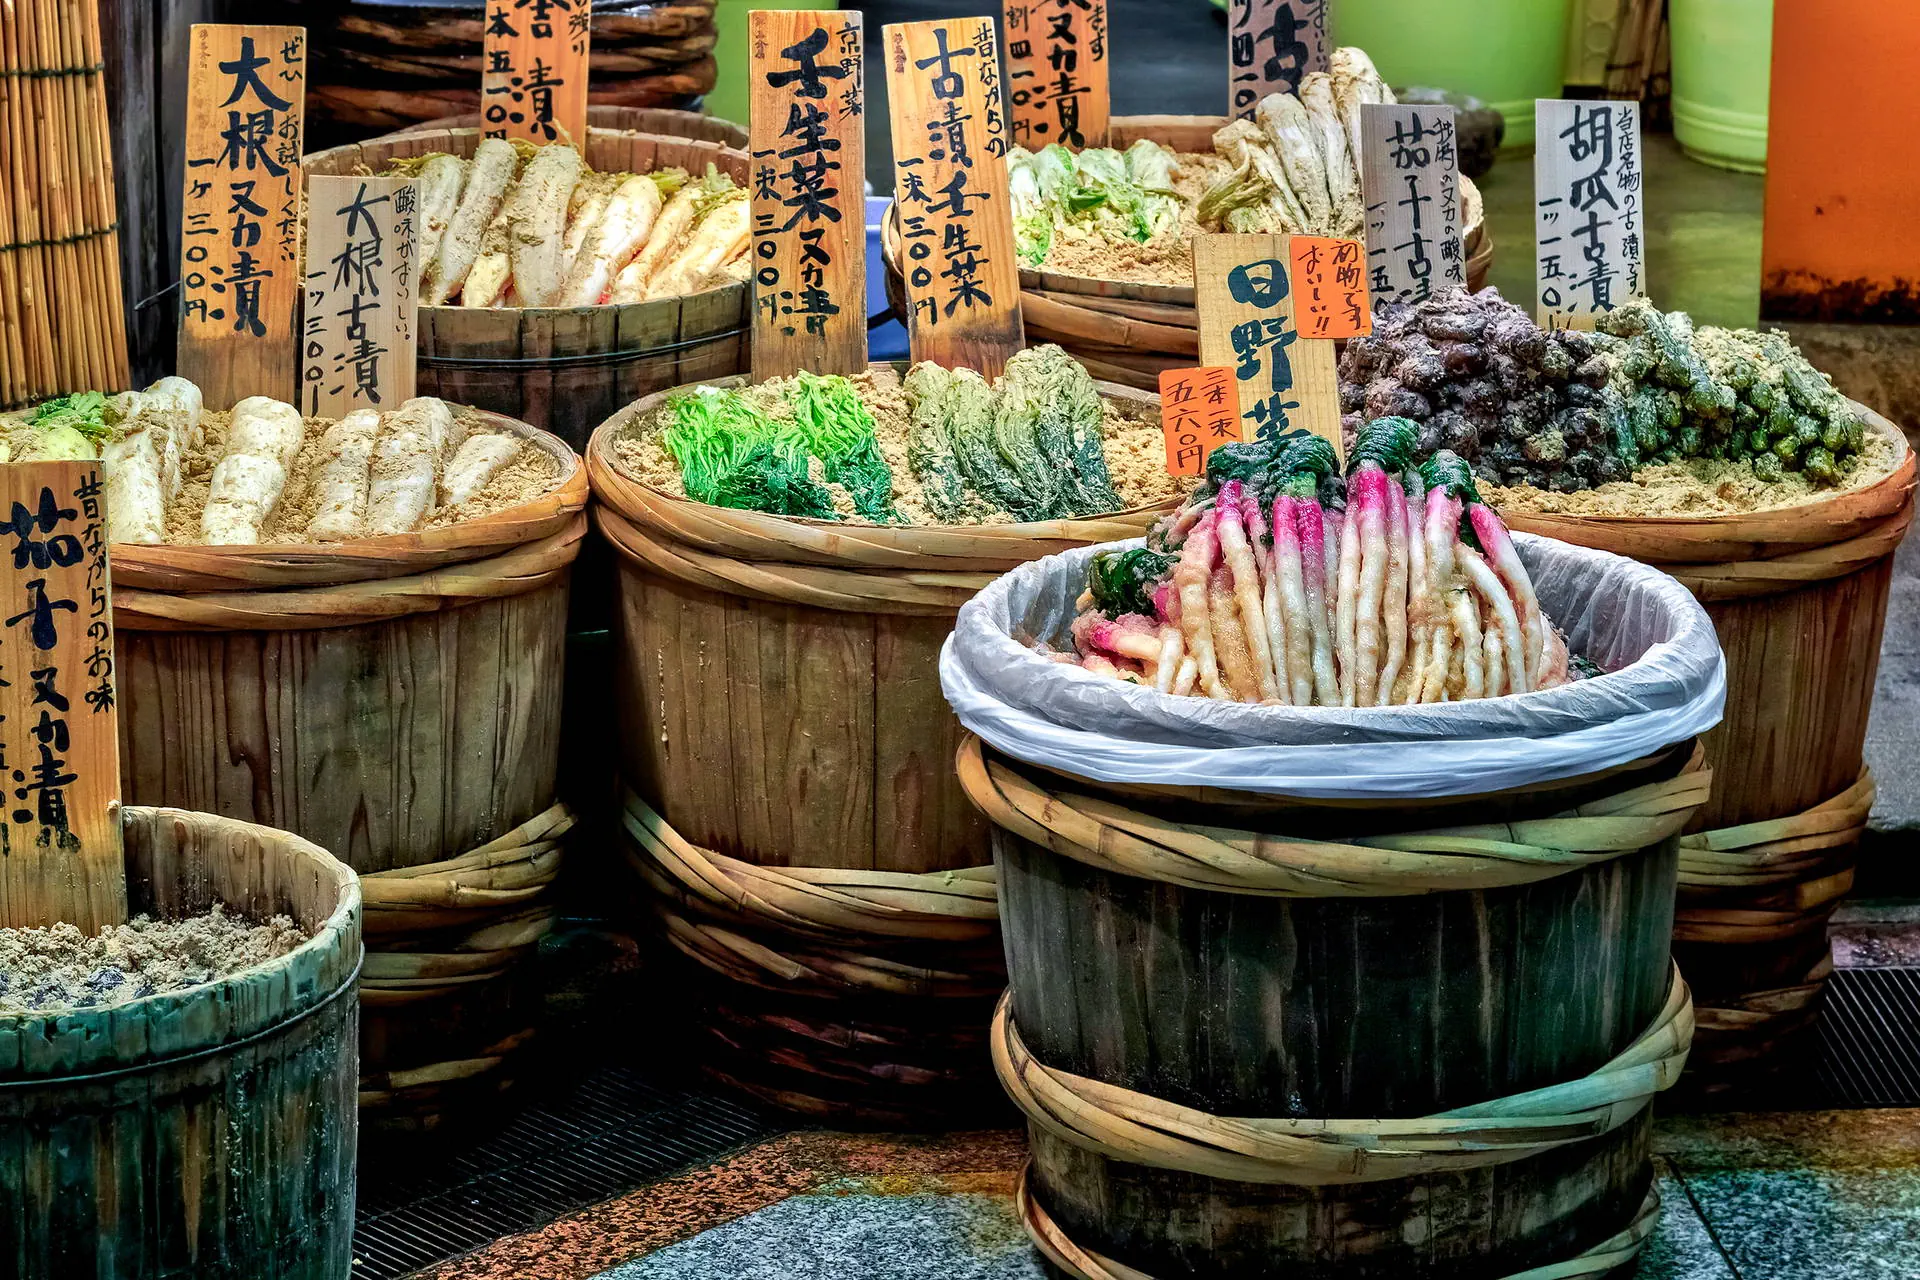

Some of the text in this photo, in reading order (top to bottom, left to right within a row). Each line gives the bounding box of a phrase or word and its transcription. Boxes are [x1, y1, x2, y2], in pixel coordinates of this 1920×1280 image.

[836, 21, 862, 122] 京野菜
[391, 184, 417, 341] 酸味がおいしい。
[914, 28, 993, 318] 古漬壬生菜
[1559, 104, 1619, 313] 胡瓜古漬
[329, 182, 390, 404] 大根古漬
[1166, 378, 1204, 475] 五六〇円
